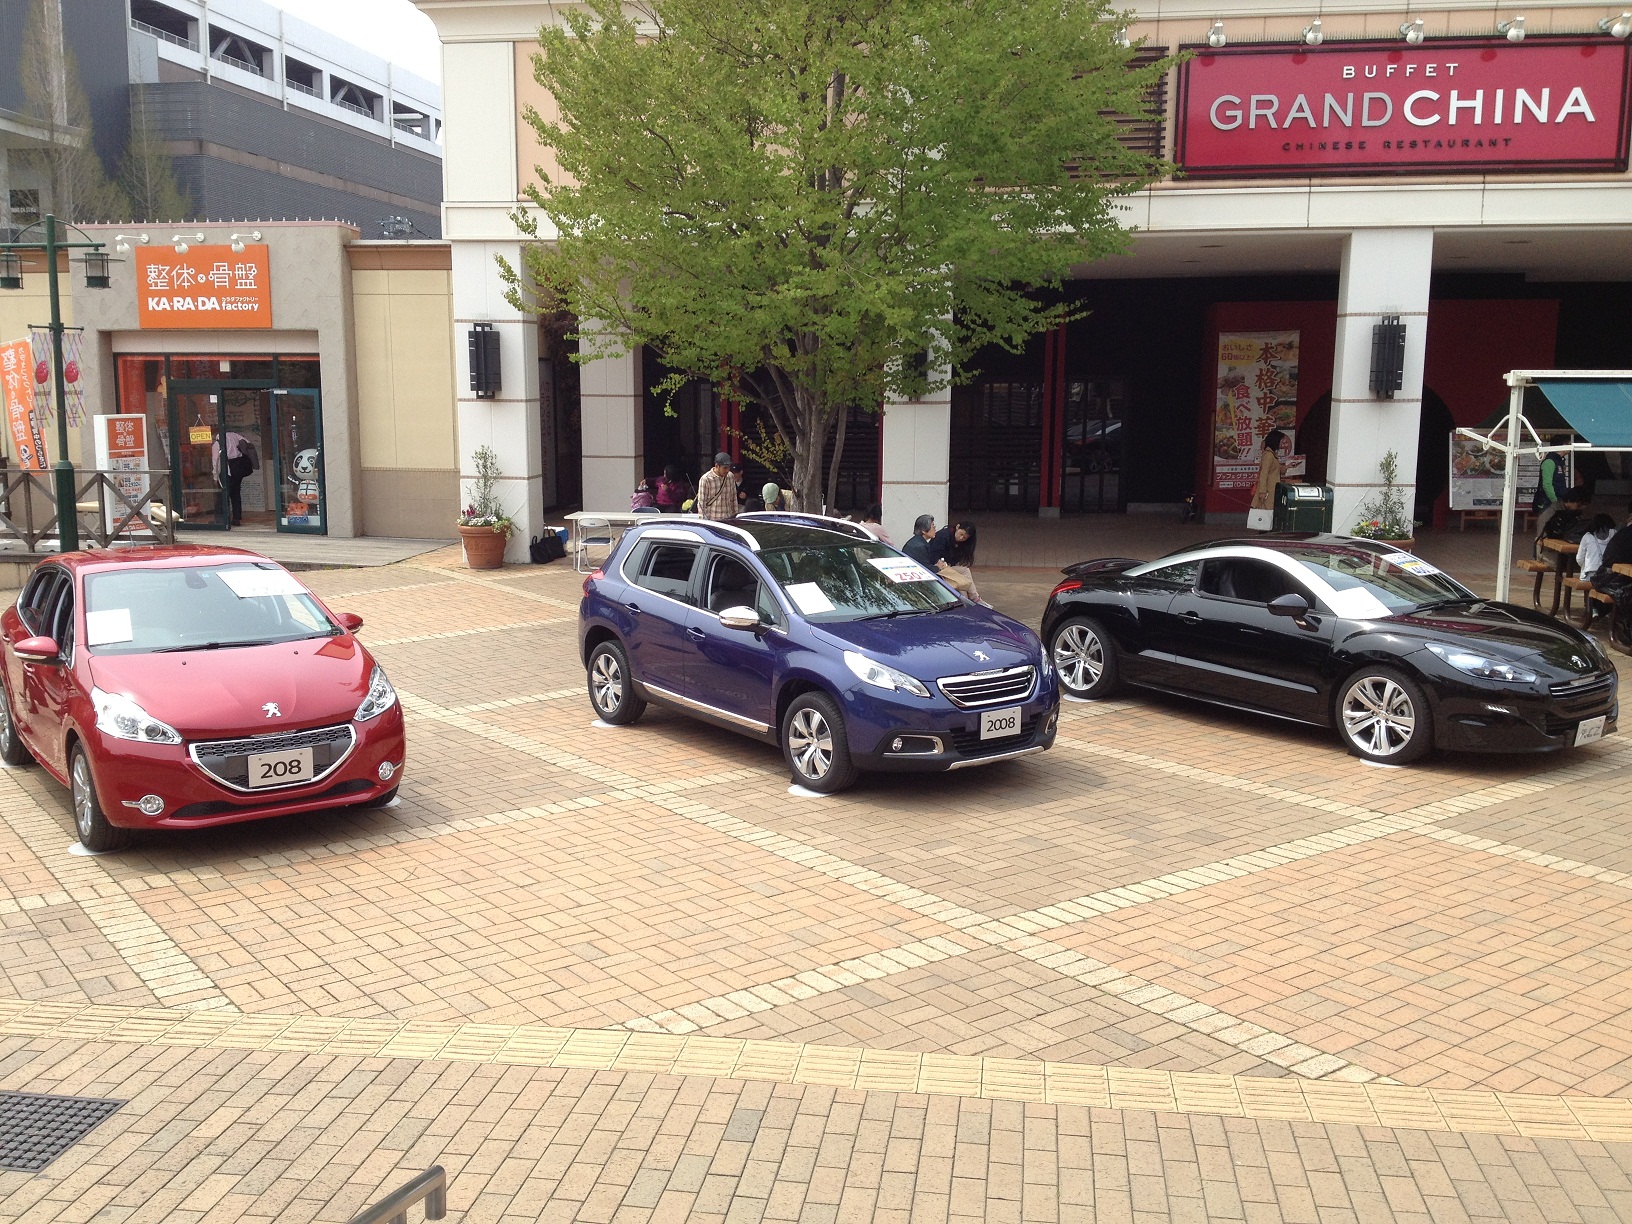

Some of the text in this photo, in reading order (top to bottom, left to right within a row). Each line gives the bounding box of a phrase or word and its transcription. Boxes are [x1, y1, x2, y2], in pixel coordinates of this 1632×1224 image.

[1343, 63, 1459, 79] BUFFET
[1209, 86, 1596, 131] GRAND CHINA
[1282, 138, 1513, 151] CHINESE RESTAURANT
[221, 301, 259, 311] factory
[1254, 342, 1281, 438] 本格中華
[190, 432, 211, 441] OPEN
[895, 571, 923, 581] 250
[986, 716, 1016, 733] 2008
[260, 759, 302, 779] 208
